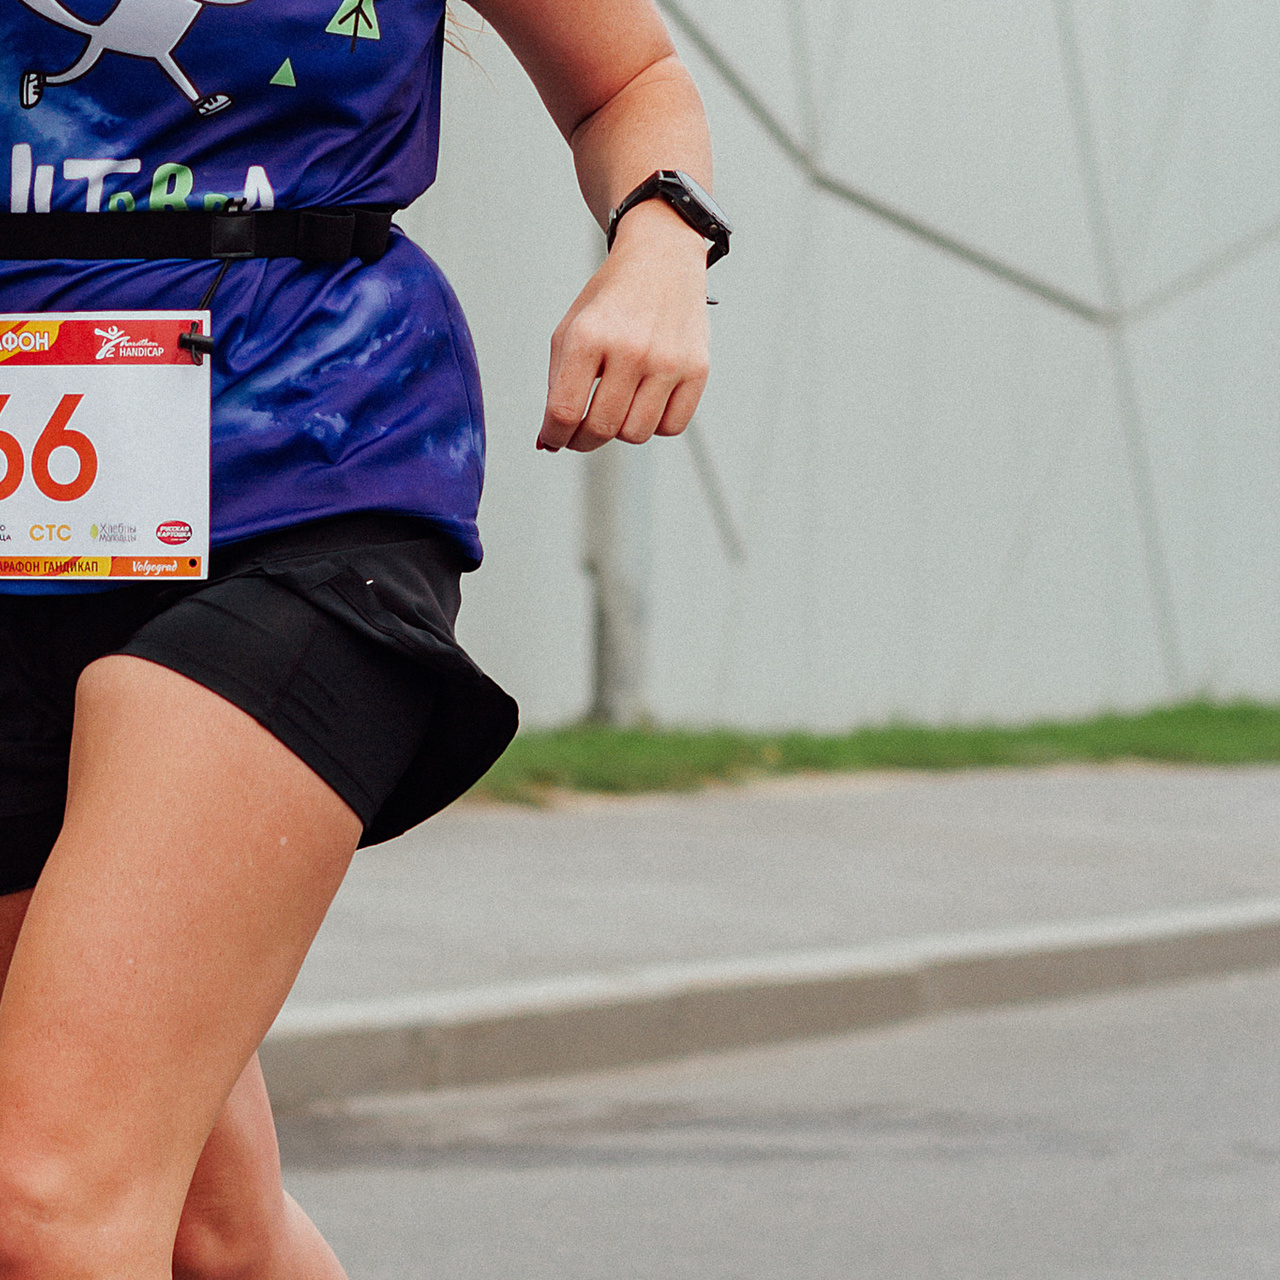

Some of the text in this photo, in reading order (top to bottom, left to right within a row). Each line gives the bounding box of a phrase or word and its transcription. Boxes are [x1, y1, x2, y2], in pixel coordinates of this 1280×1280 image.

[119, 347, 164, 357] HANDICAP
[43, 560, 99, 574] ГАНДИКАП
[132, 559, 178, 576] Volgograd
